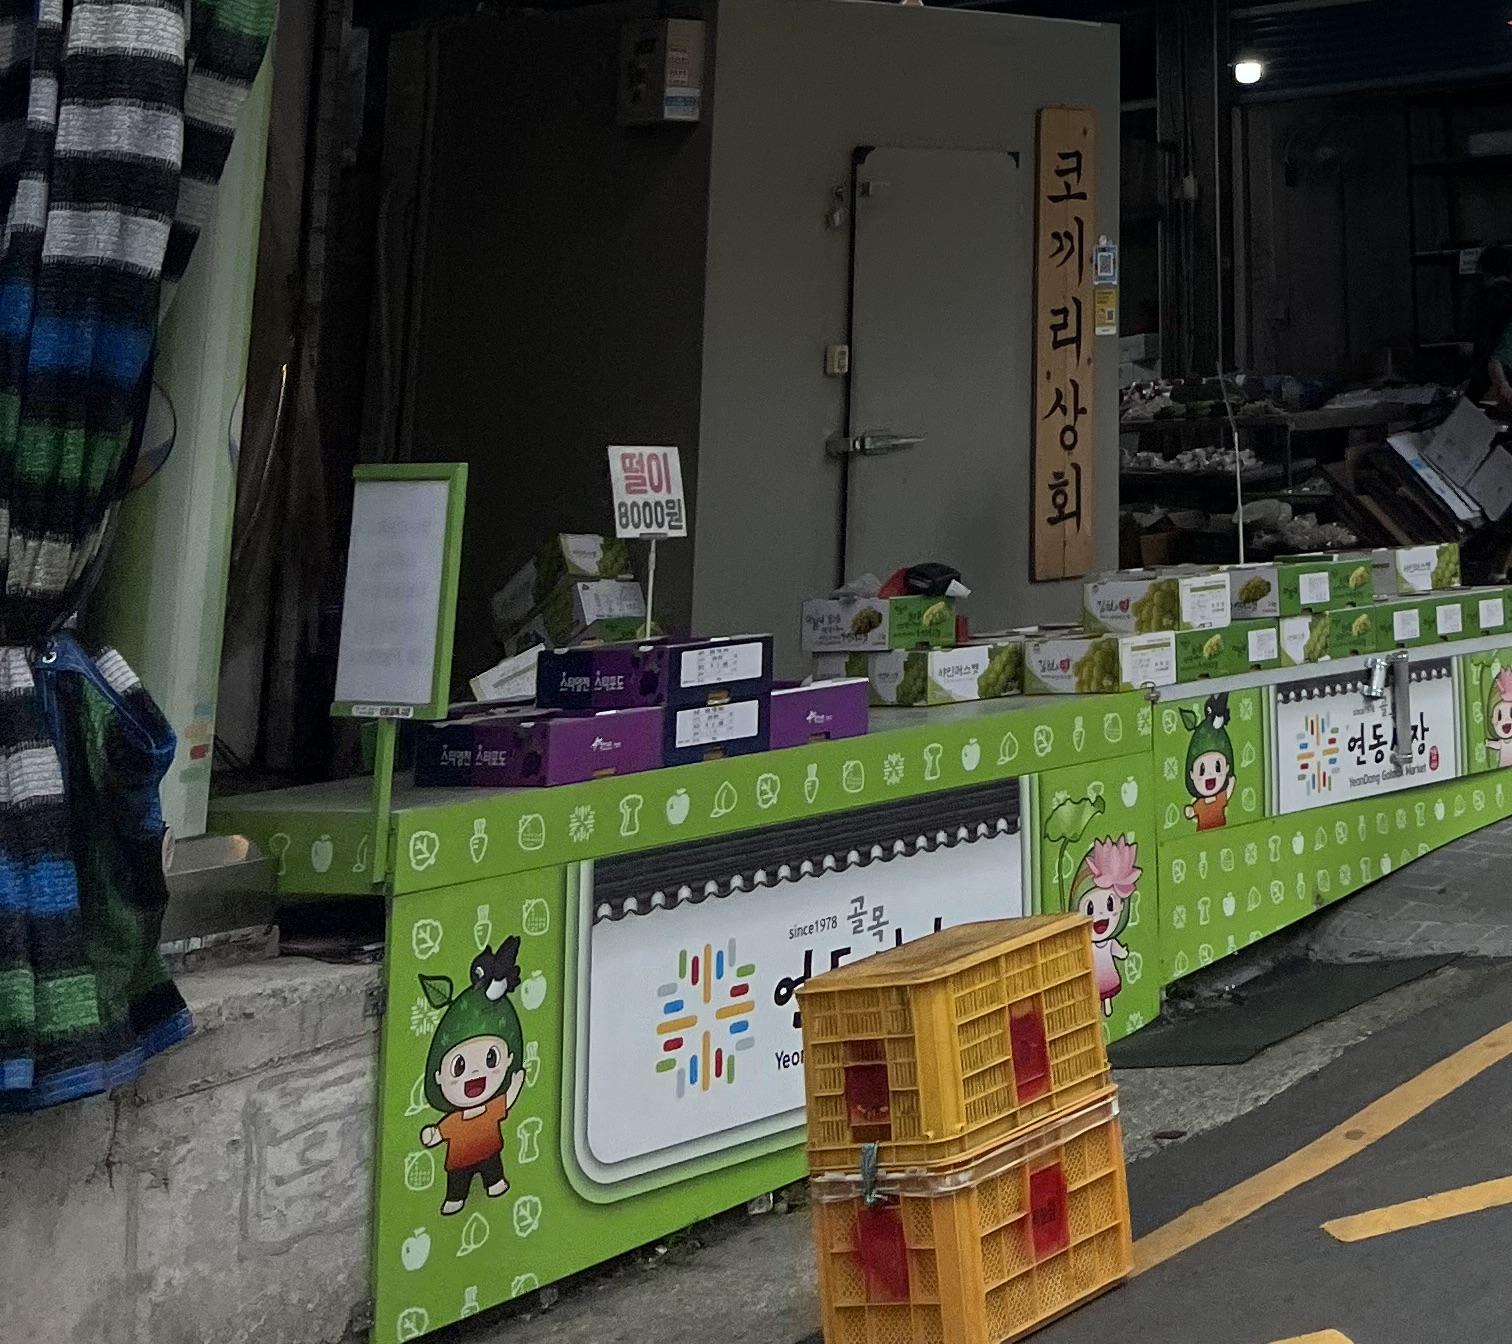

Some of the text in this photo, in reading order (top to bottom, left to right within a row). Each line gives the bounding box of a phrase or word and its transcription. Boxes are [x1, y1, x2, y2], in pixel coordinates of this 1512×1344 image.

[1045, 150, 1089, 533] 코끼리상회
[620, 451, 672, 496] 떨이
[1349, 773, 1381, 788] YeonDong
[788, 915, 839, 941] since1978
[846, 895, 890, 943] 골목
